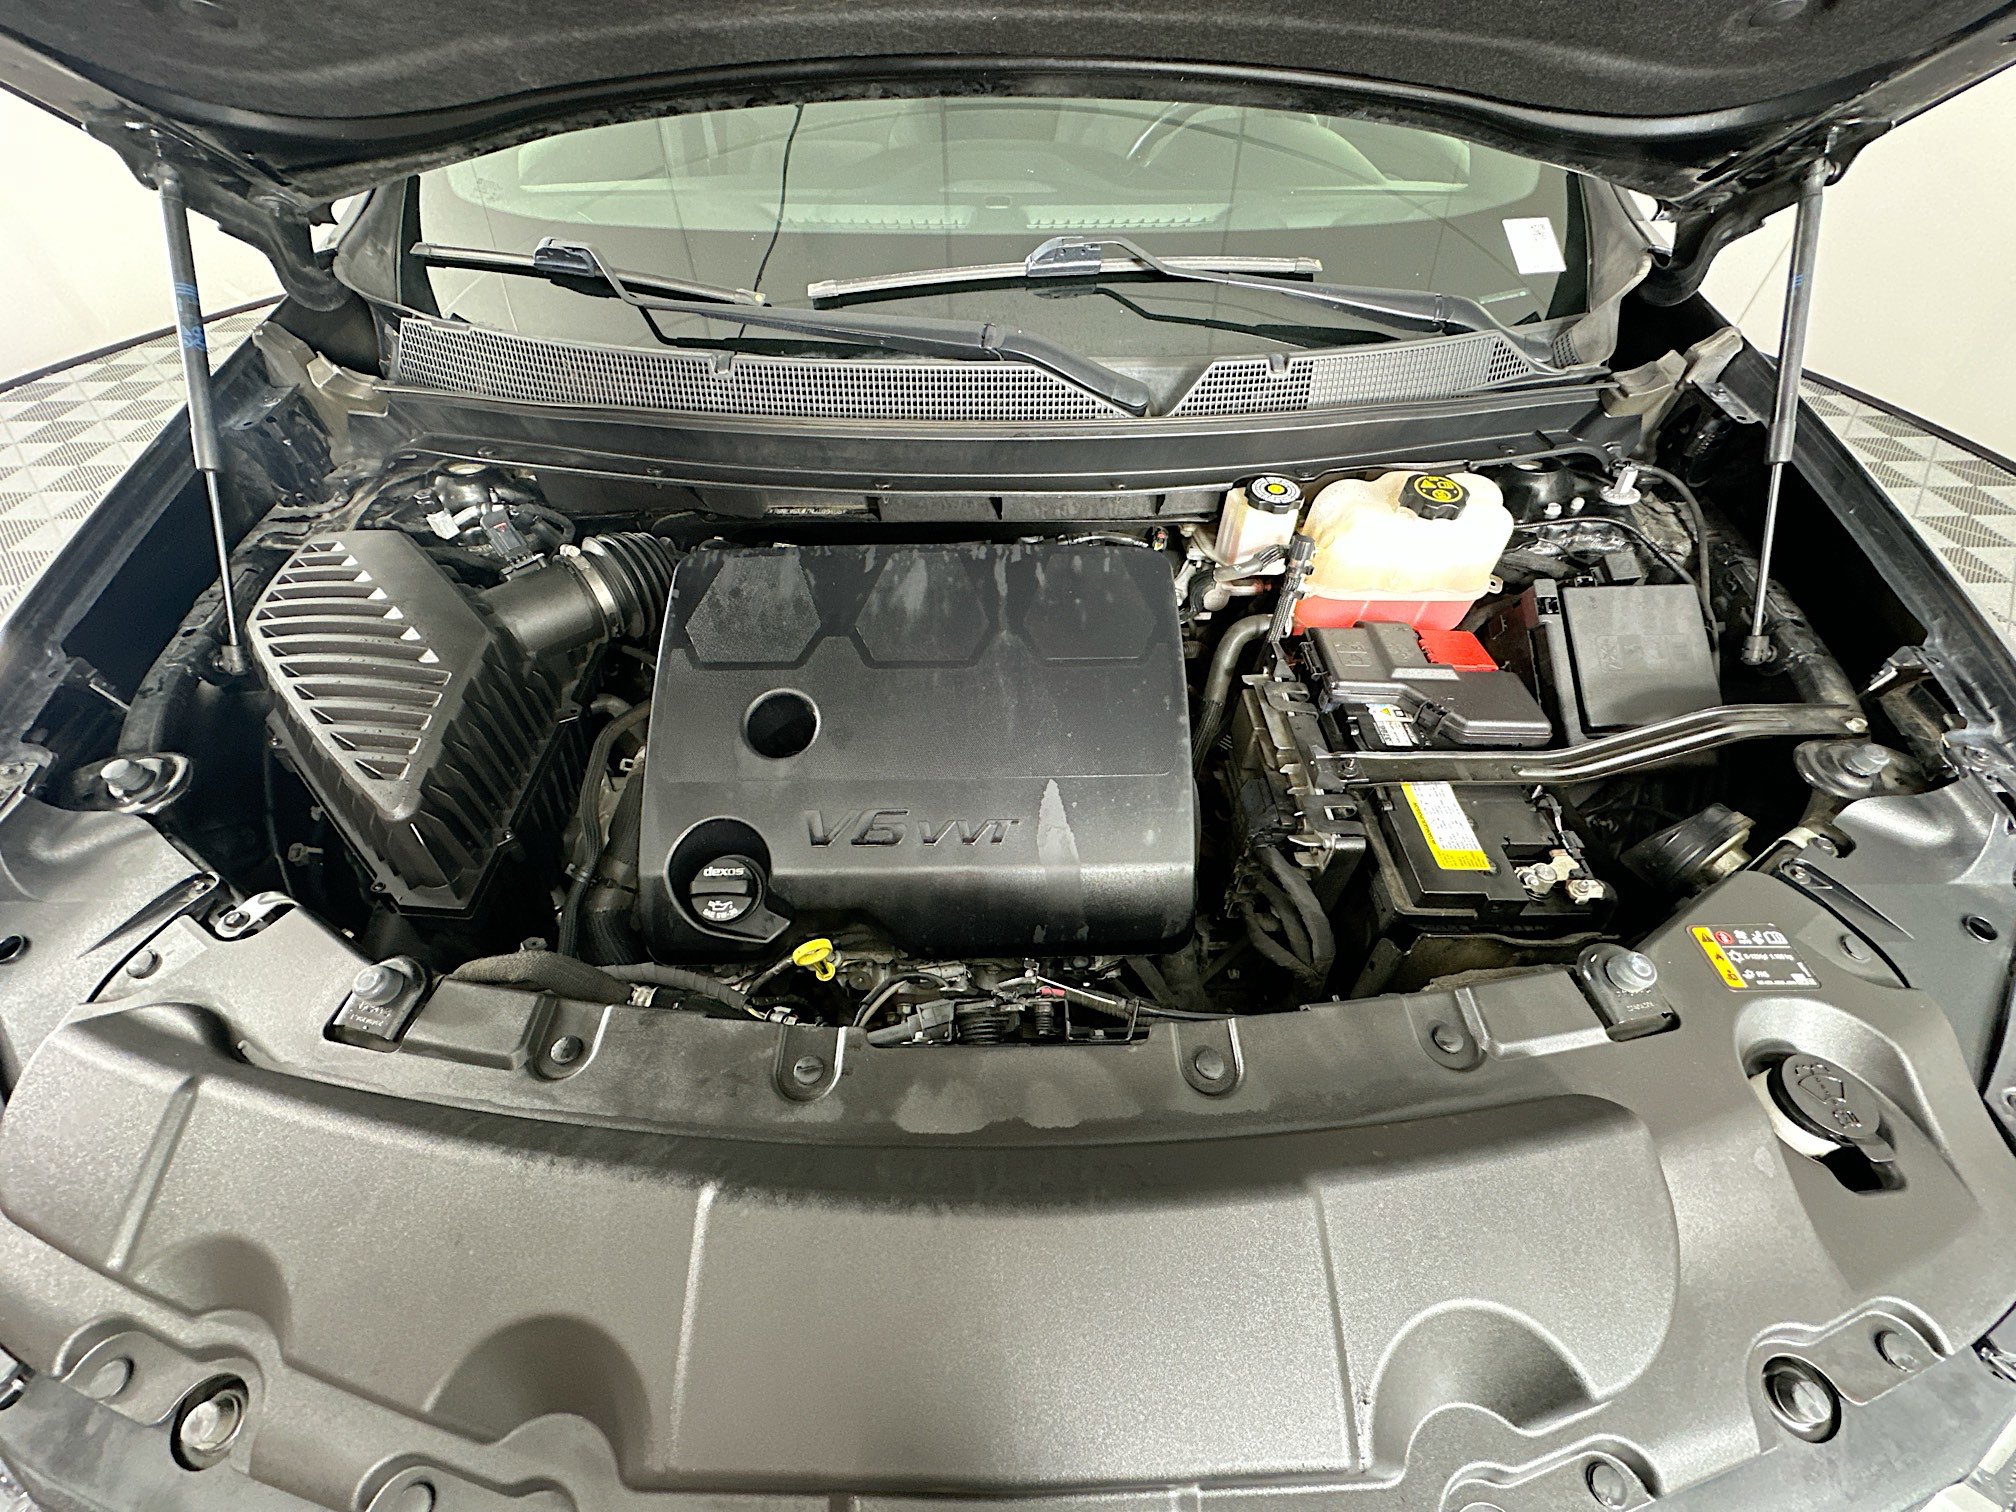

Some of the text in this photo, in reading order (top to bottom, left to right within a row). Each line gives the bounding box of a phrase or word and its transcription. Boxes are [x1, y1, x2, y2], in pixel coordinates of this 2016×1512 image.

[803, 808, 1020, 848] V6 VVT
[703, 866, 745, 877] dexos
